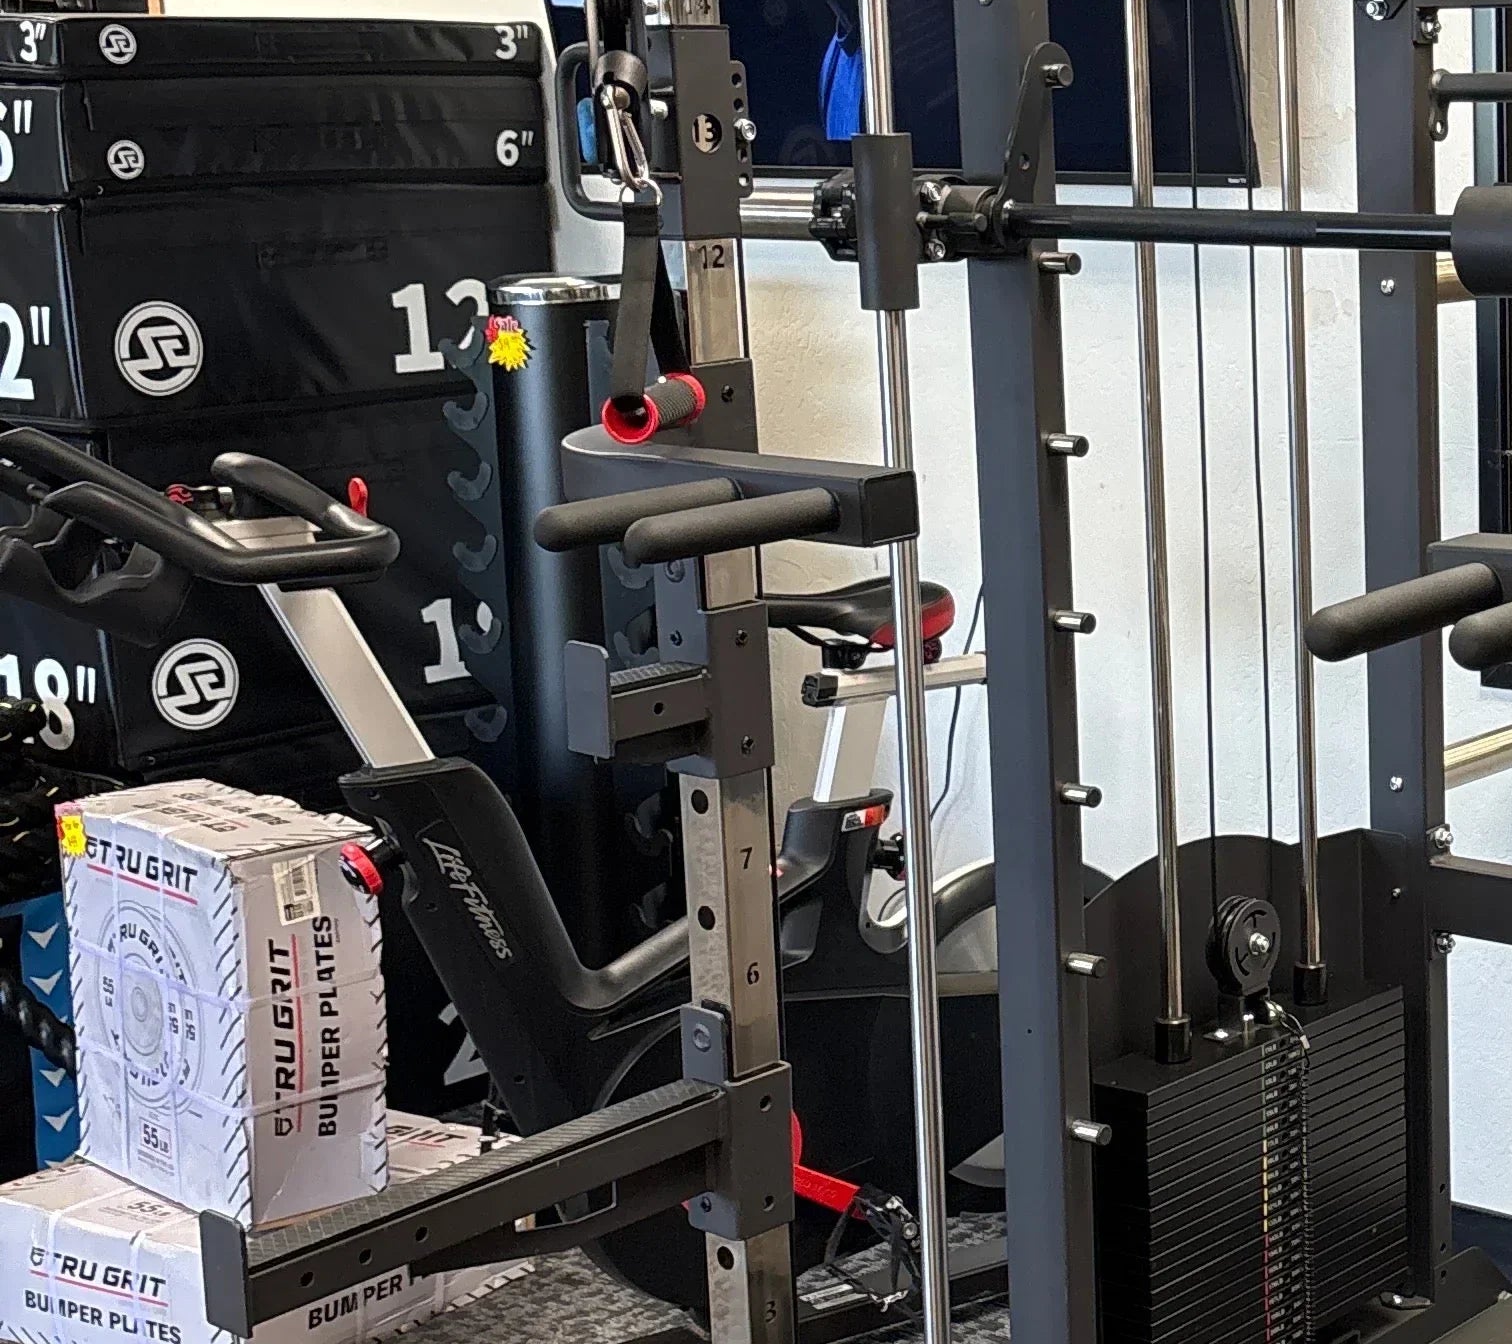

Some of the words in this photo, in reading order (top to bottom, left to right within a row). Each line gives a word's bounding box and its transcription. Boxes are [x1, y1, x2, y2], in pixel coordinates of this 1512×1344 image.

[700, 244, 725, 270] 12
[739, 846, 753, 870] 7
[146, 858, 199, 894] GRIT
[746, 961, 760, 985] 6
[307, 1273, 404, 1330] BUMPER
[764, 1300, 777, 1324] 3
